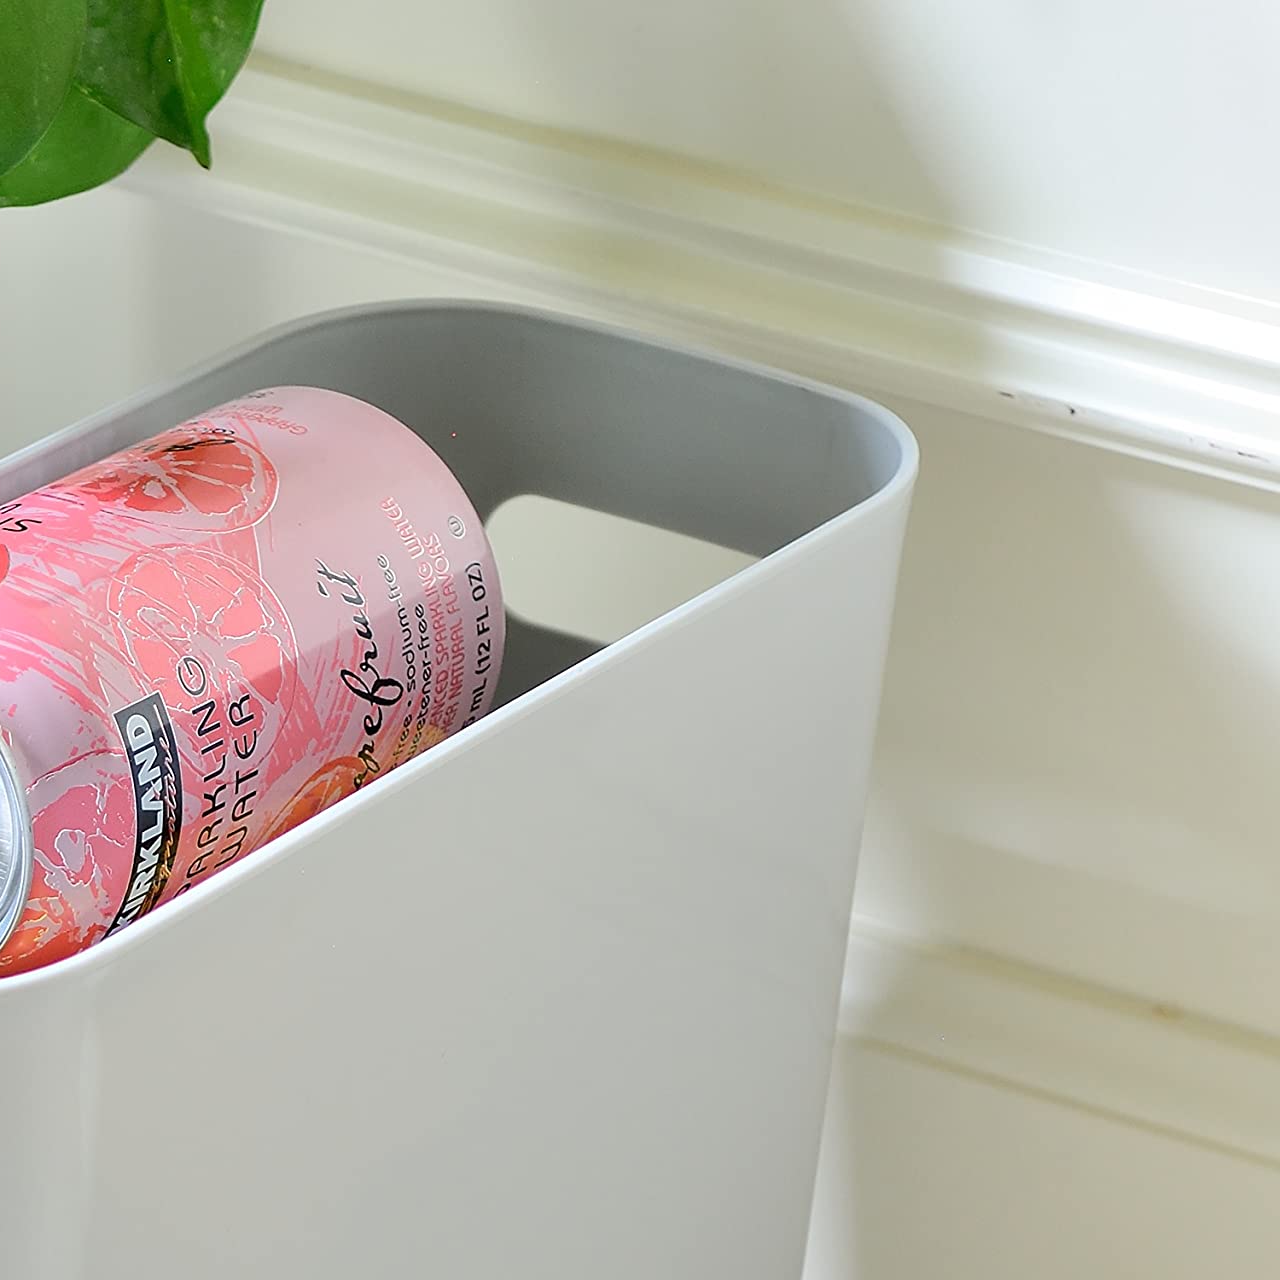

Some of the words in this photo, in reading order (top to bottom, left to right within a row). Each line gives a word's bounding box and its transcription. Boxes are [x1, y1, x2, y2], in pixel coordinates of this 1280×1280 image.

[380, 496, 425, 560] WATER
[423, 532, 461, 615] FLAVORS
[465, 562, 487, 602] OZ)
[376, 554, 417, 692] sodium-free
[449, 618, 466, 701] NATURAL
[475, 639, 492, 675] (12
[476, 605, 491, 637] FL
[315, 558, 404, 791] apefruit
[406, 603, 432, 758] weetener-free
[214, 694, 260, 868] WATER
